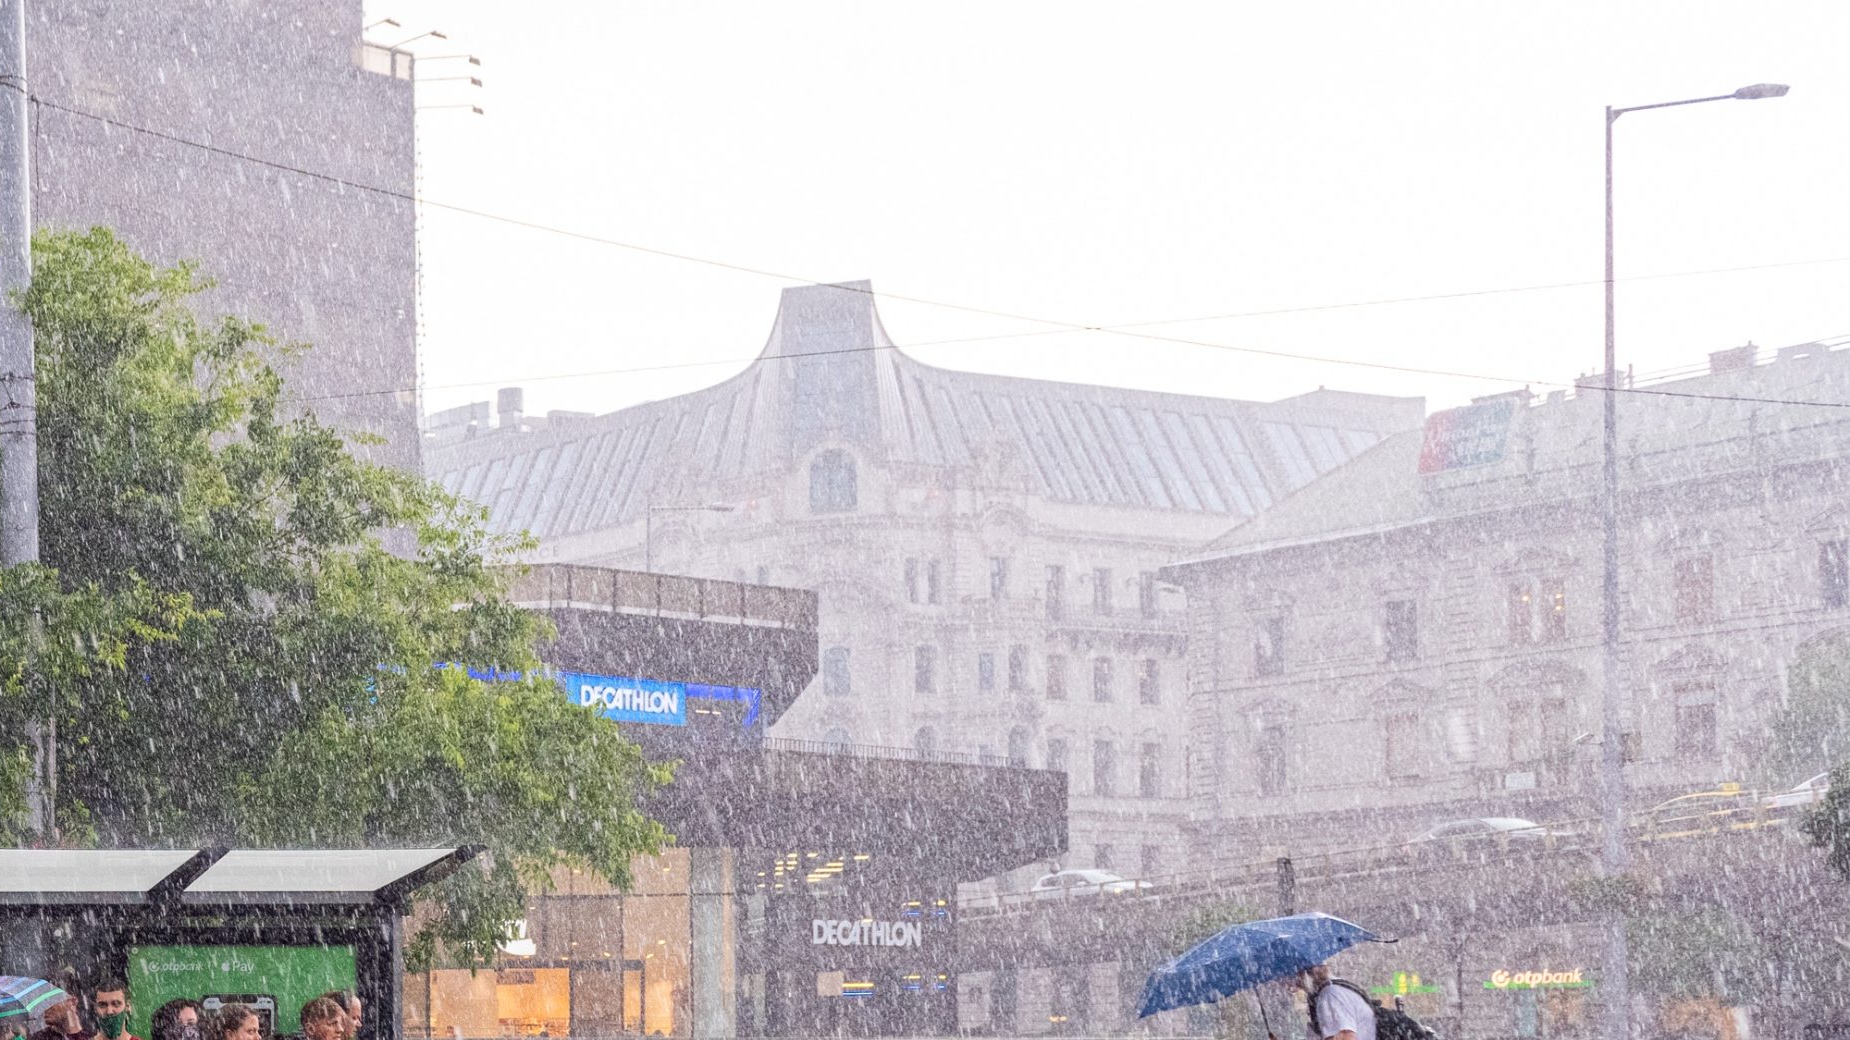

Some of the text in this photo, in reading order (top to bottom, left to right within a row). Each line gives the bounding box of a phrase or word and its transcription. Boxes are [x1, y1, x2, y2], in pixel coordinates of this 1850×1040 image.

[580, 684, 678, 714] DECATHLON
[812, 919, 922, 947] DECATHLON
[232, 961, 255, 973] Pay
[1513, 968, 1583, 988] otpbank
